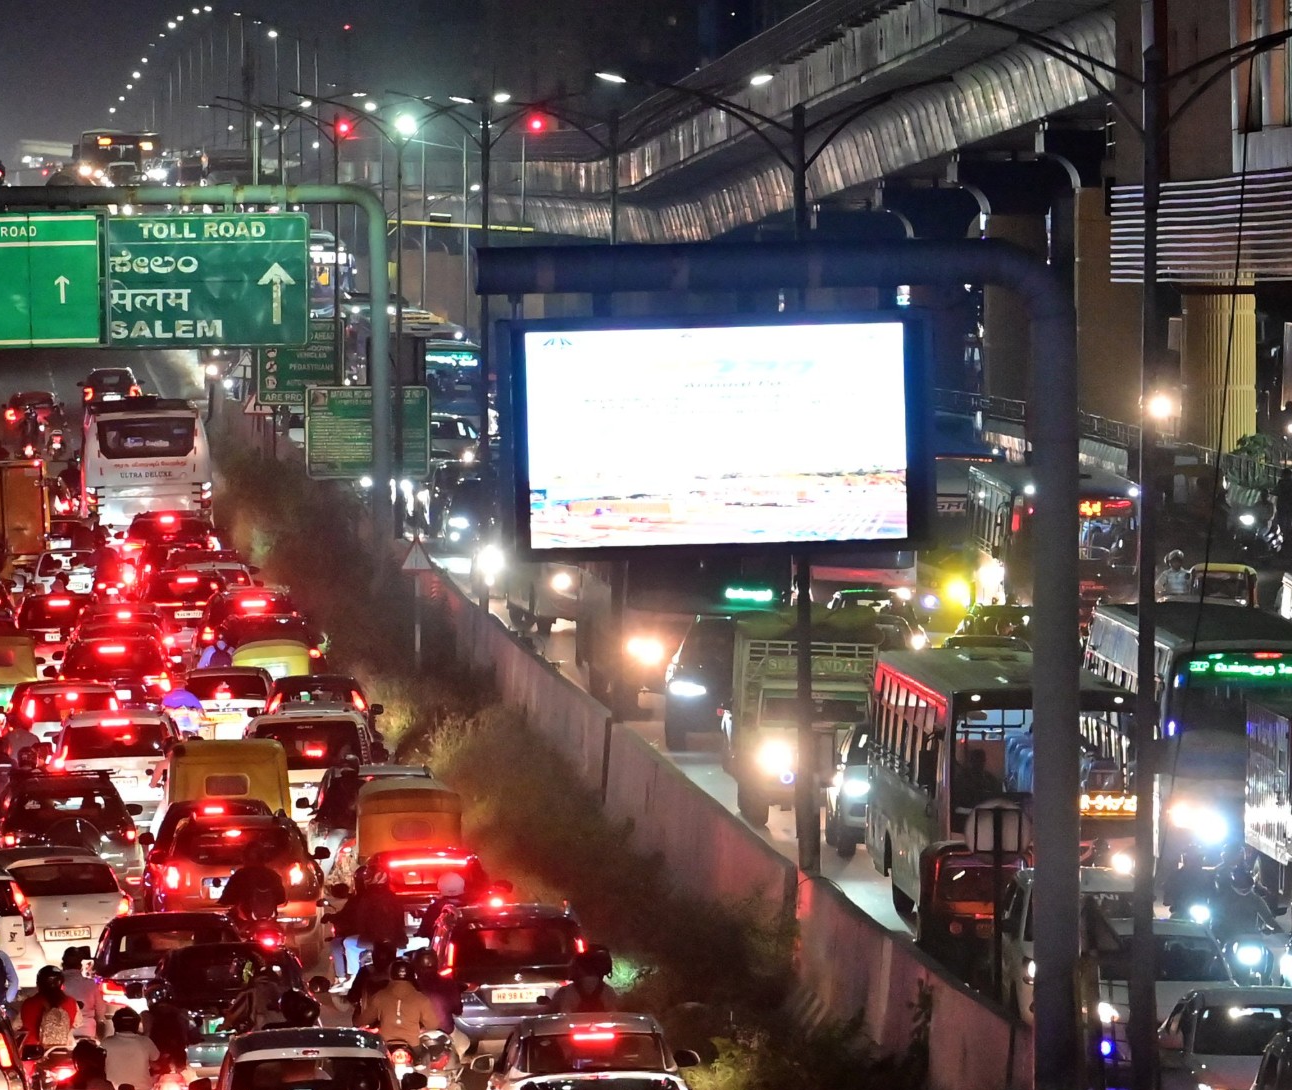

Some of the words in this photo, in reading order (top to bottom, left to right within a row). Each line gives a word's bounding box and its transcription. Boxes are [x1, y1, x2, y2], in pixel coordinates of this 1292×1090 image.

[0, 226, 37, 237] ROAD
[139, 222, 197, 239] TOLL
[203, 221, 266, 238] ROAD
[111, 320, 223, 339] SALEM
[120, 471, 142, 479] ULTRA
[145, 470, 172, 478] DELUXE
